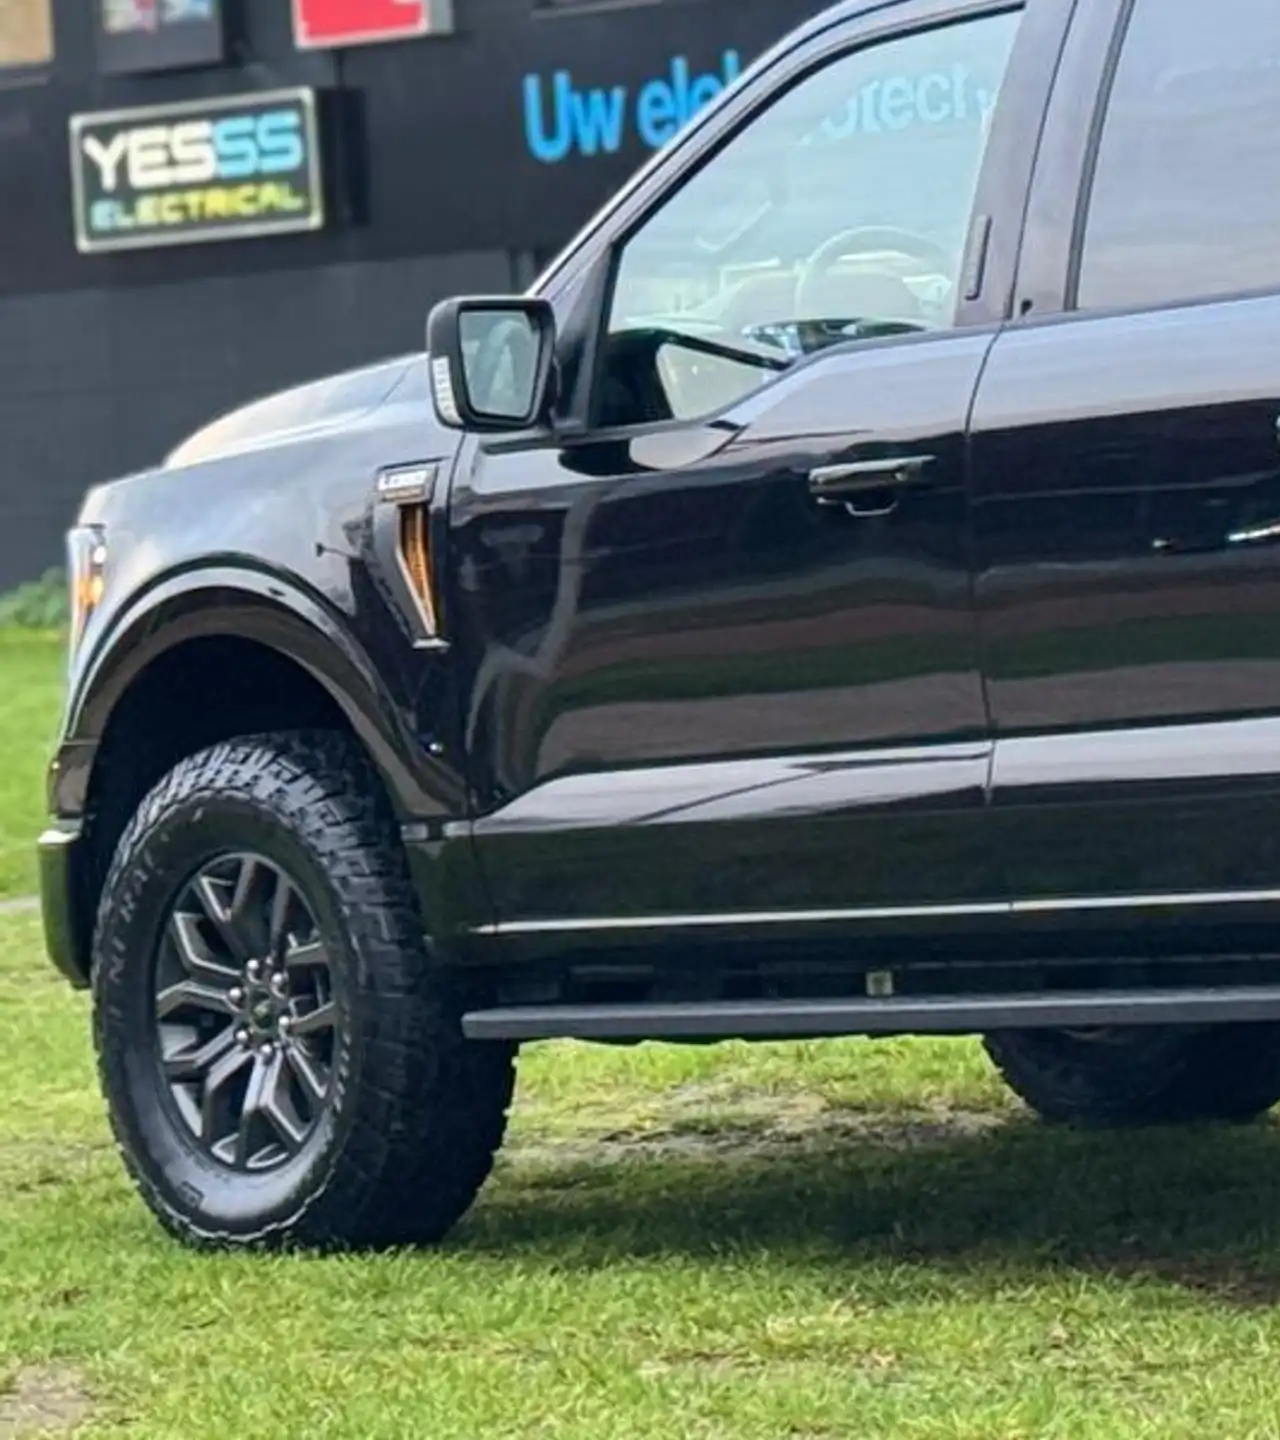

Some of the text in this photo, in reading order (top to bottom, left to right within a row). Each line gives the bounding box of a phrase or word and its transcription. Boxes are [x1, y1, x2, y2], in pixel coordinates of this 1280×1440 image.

[82, 110, 304, 193] YESSS
[522, 67, 628, 165] Uw
[90, 180, 304, 232] ELECTRICAL
